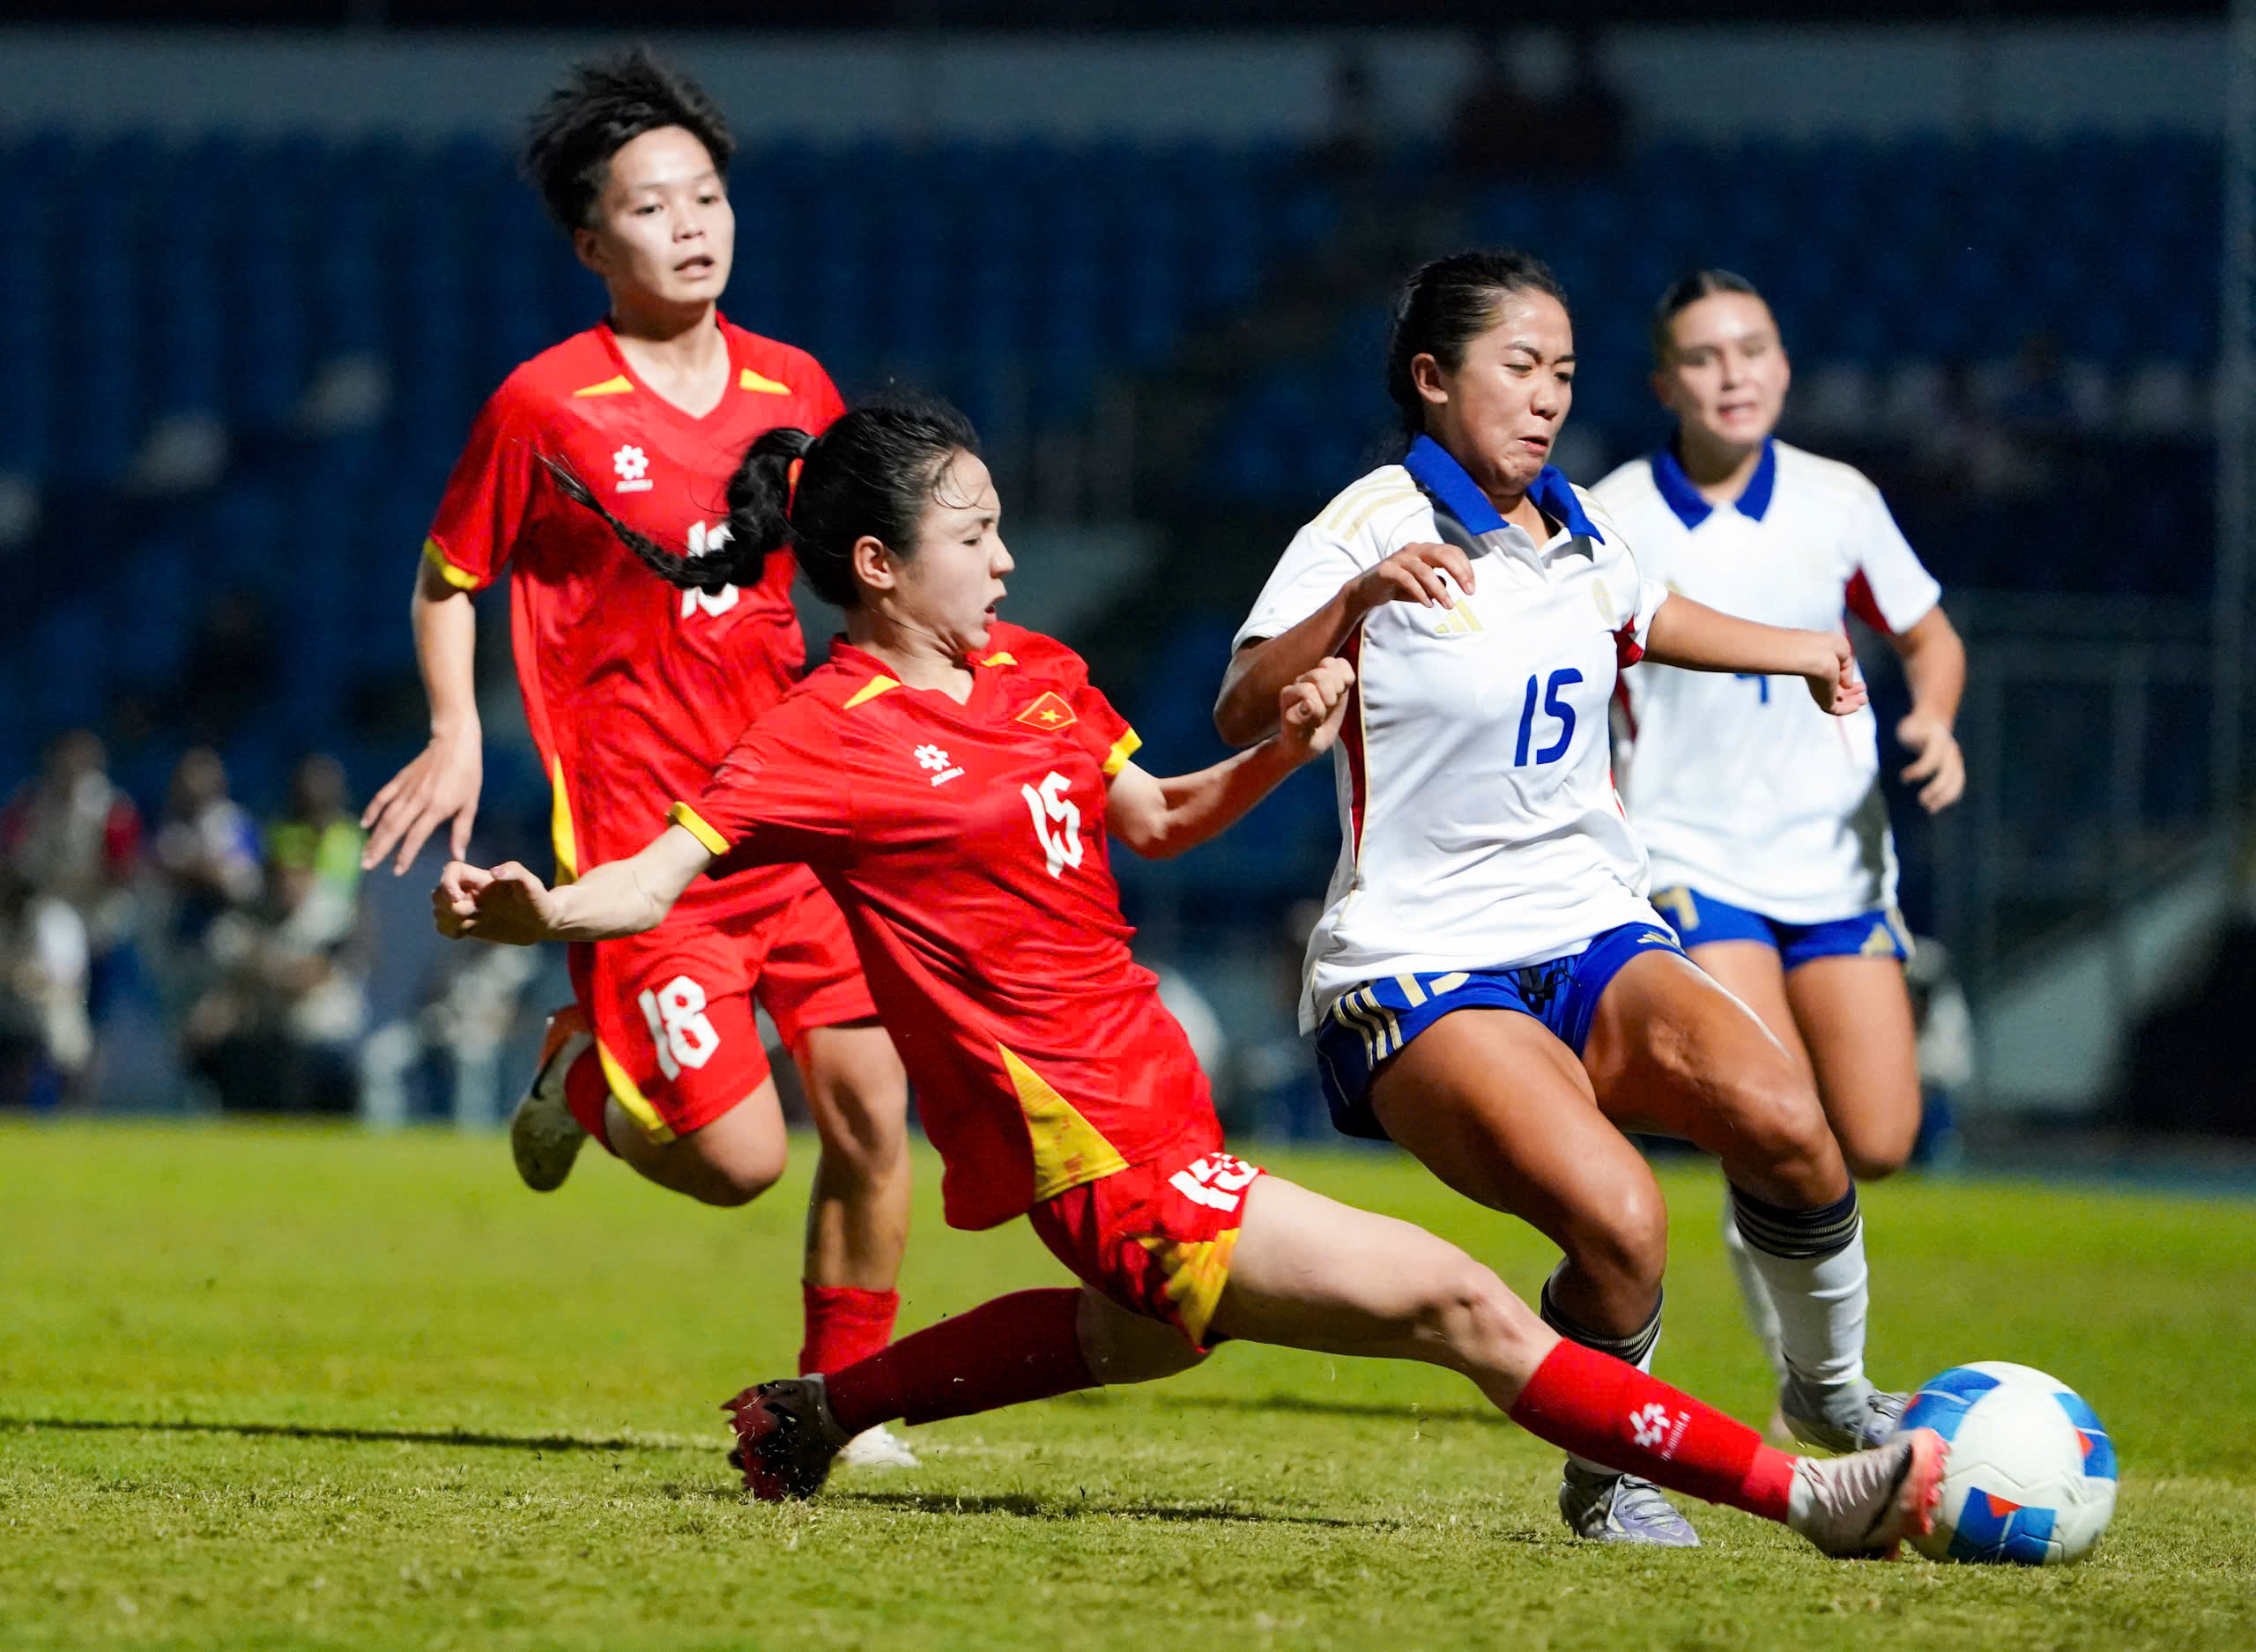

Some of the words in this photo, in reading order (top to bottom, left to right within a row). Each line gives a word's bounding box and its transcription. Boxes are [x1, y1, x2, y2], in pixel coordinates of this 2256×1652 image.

[1514, 667, 1583, 767] 15
[1020, 771, 1084, 879] 15
[637, 975, 721, 1083] 18
